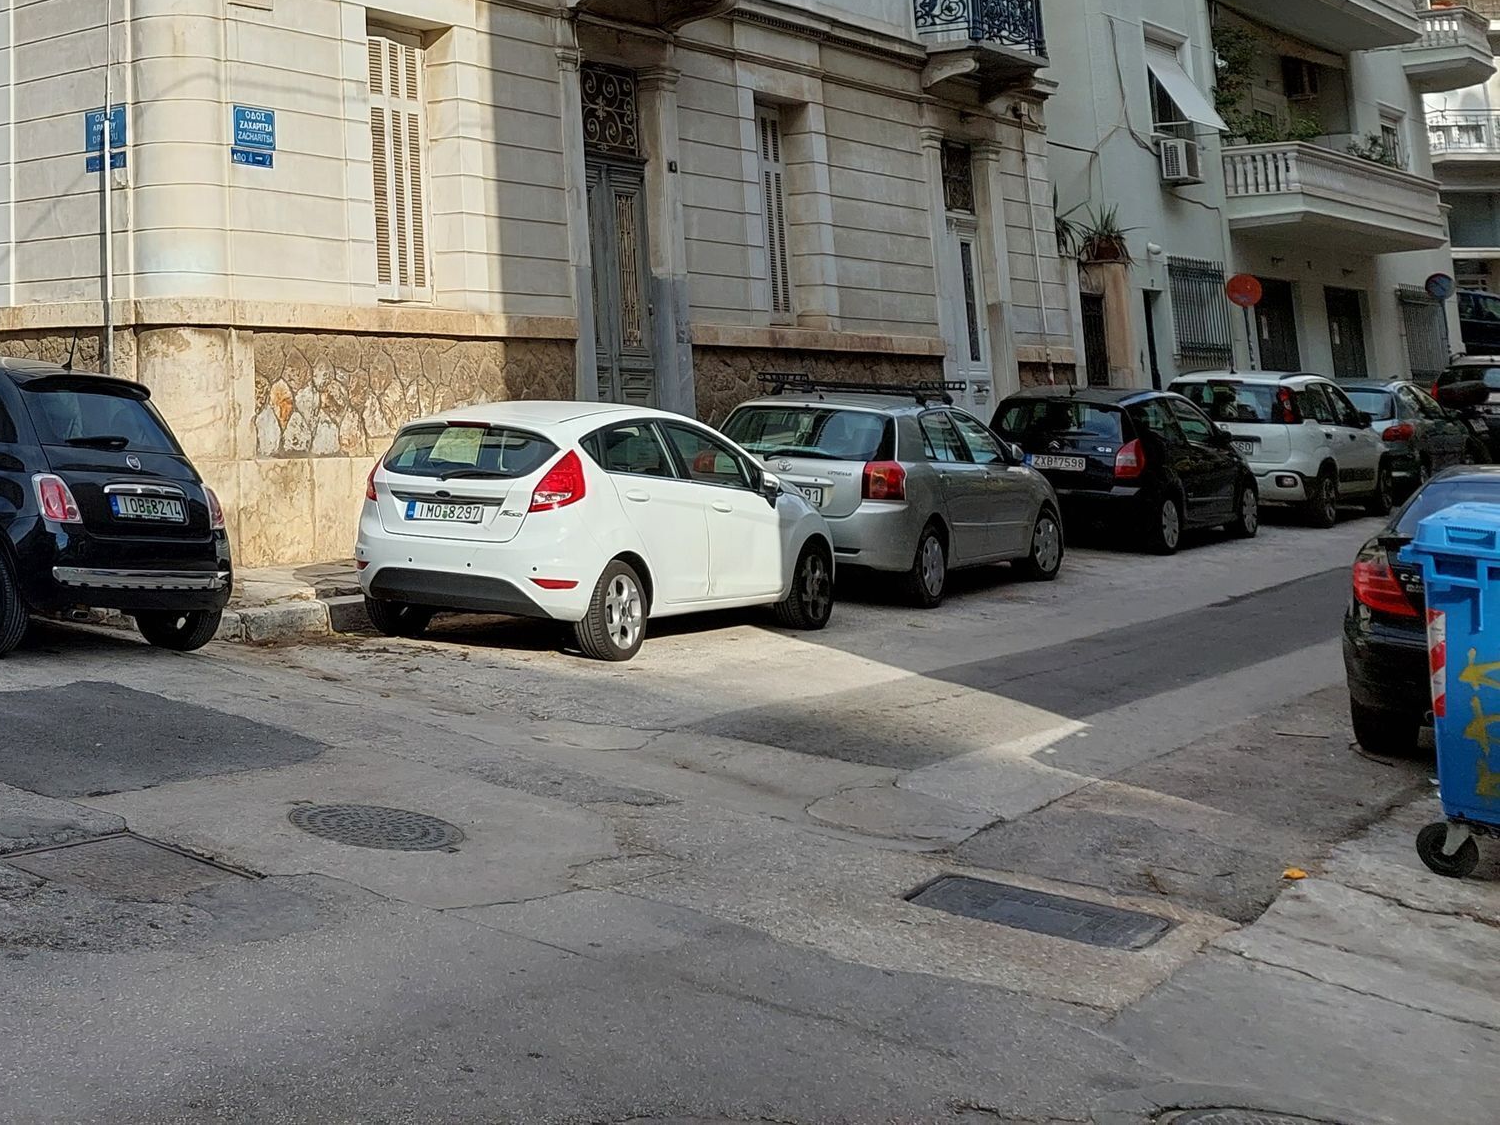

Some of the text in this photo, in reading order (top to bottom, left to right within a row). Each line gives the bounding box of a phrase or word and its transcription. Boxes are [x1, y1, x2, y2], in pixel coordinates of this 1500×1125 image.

[94, 111, 115, 123] ΟΔΣ
[245, 111, 266, 121] ΟΔΟΣ
[239, 120, 273, 132] ΖΑΧΑΡΙΤΣΑ
[237, 131, 274, 144] ZACHARITSA
